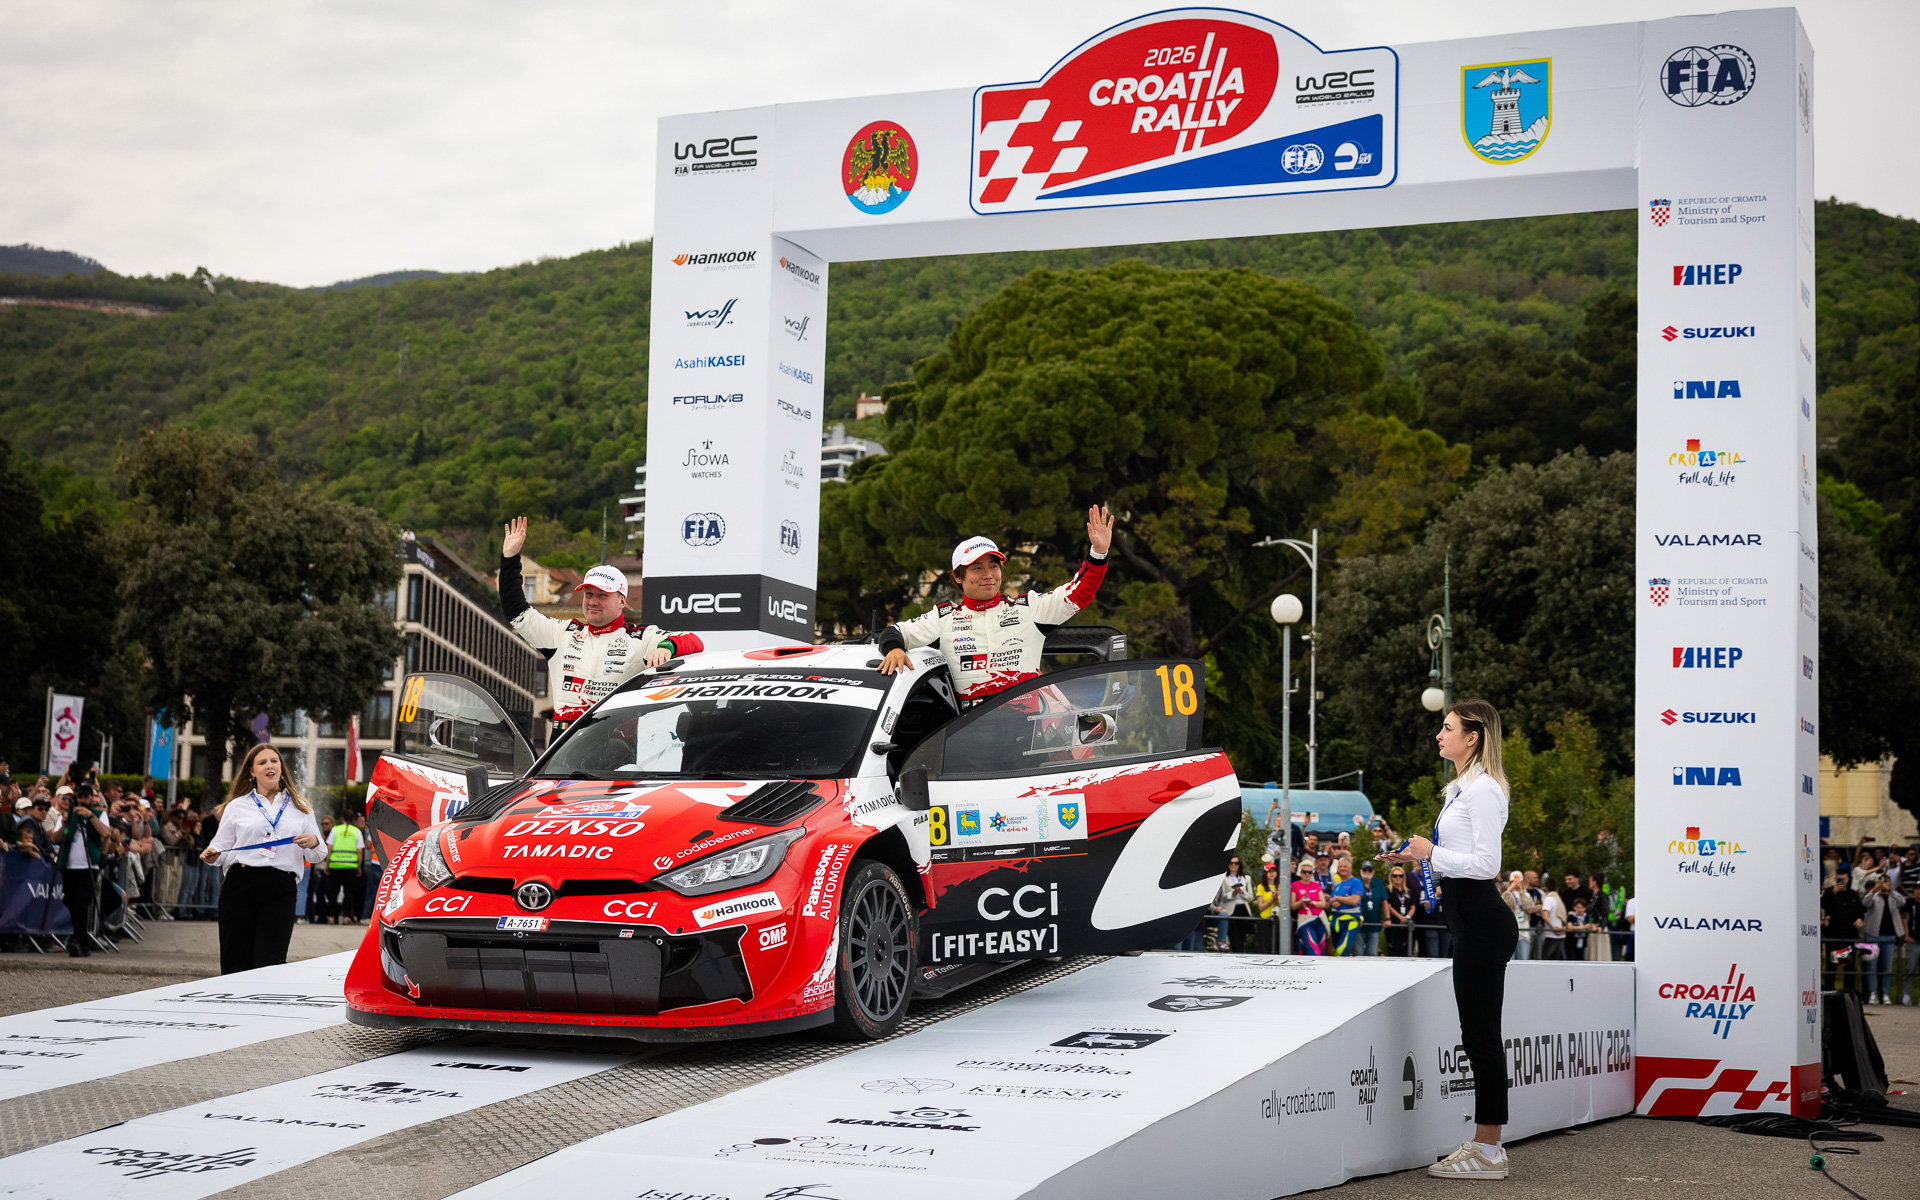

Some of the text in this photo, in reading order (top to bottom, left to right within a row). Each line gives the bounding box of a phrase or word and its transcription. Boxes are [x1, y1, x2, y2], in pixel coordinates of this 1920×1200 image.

[1144, 45, 1196, 68] 2026
[1088, 45, 1245, 107] CROATIA
[1295, 69, 1375, 91] WRC
[1297, 99, 1372, 109] CHAMPIONSHIP
[1312, 93, 1341, 101] WORLD
[1131, 98, 1241, 142] RALLY
[675, 135, 758, 160] WRC
[1678, 197, 1718, 205] REPUBLIC
[1731, 195, 1767, 203] CROATIA
[1678, 205, 1732, 216] Ministry of
[1678, 215, 1766, 226] Tourism and Sport
[703, 263, 755, 273] driving emotion
[1697, 264, 1743, 285] HEP
[1682, 326, 1756, 339] SUZUKI
[673, 394, 744, 405] FORUM8
[777, 399, 812, 420] FORUM8
[1668, 450, 1747, 467] CROATIA
[1678, 472, 1700, 484] Full
[1719, 471, 1736, 485] life
[1655, 534, 1762, 547] VALAMAR
[1677, 586, 1732, 598] Ministry of
[661, 593, 742, 614] WRC
[768, 596, 808, 625] WRC
[1677, 597, 1766, 607] Tourism and Sport
[990, 655, 1020, 663] GAZOO
[991, 648, 1023, 658] TOYOTA
[1697, 647, 1743, 668] HEP
[989, 661, 1019, 669] Racing
[678, 674, 740, 683] TOYOTA
[742, 673, 803, 681] GAZOO
[805, 675, 864, 686] Racing
[583, 689, 607, 697] Racin
[1155, 663, 1198, 716] 18
[399, 676, 425, 723] 18
[1682, 712, 1756, 723] SUZUKI
[857, 794, 896, 814] TAMADIC
[503, 820, 646, 838] DENSO
[914, 814, 929, 826] PIAA
[1036, 804, 1046, 840] primorsko
[676, 827, 755, 858] codebeamer
[1668, 840, 1747, 856] CROATIA
[503, 844, 613, 860] TAMADIC
[375, 840, 414, 911] AUTOMOTIVE
[1678, 861, 1700, 873] Full
[1719, 861, 1736, 875] life
[802, 844, 838, 917] Panasonic
[819, 843, 854, 920] AUTOMOTIVE
[1424, 879, 1435, 900] RALLY
[507, 919, 539, 928] A-7651
[1654, 917, 1762, 932] VALAMAR
[759, 926, 788, 946] OMP
[1658, 973, 1756, 1003] CROATIA
[1685, 1003, 1754, 1026] RALLY
[1438, 1044, 1470, 1075] WR
[1568, 1030, 1603, 1082] RALLY
[1606, 1028, 1631, 1073] 2026
[956, 1060, 1106, 1070] primorsko
[996, 1065, 1131, 1075] goranska
[1350, 1060, 1379, 1086] CROATIA
[316, 1084, 463, 1098] CROATIA
[1358, 1087, 1379, 1112] RALLY
[1260, 1087, 1336, 1125] rally-croatia.com
[203, 1112, 366, 1130] VALAMAR
[83, 1146, 260, 1169] CROATIA
[800, 1141, 935, 1156] OPATIJA
[98, 1157, 230, 1176] RALLY
